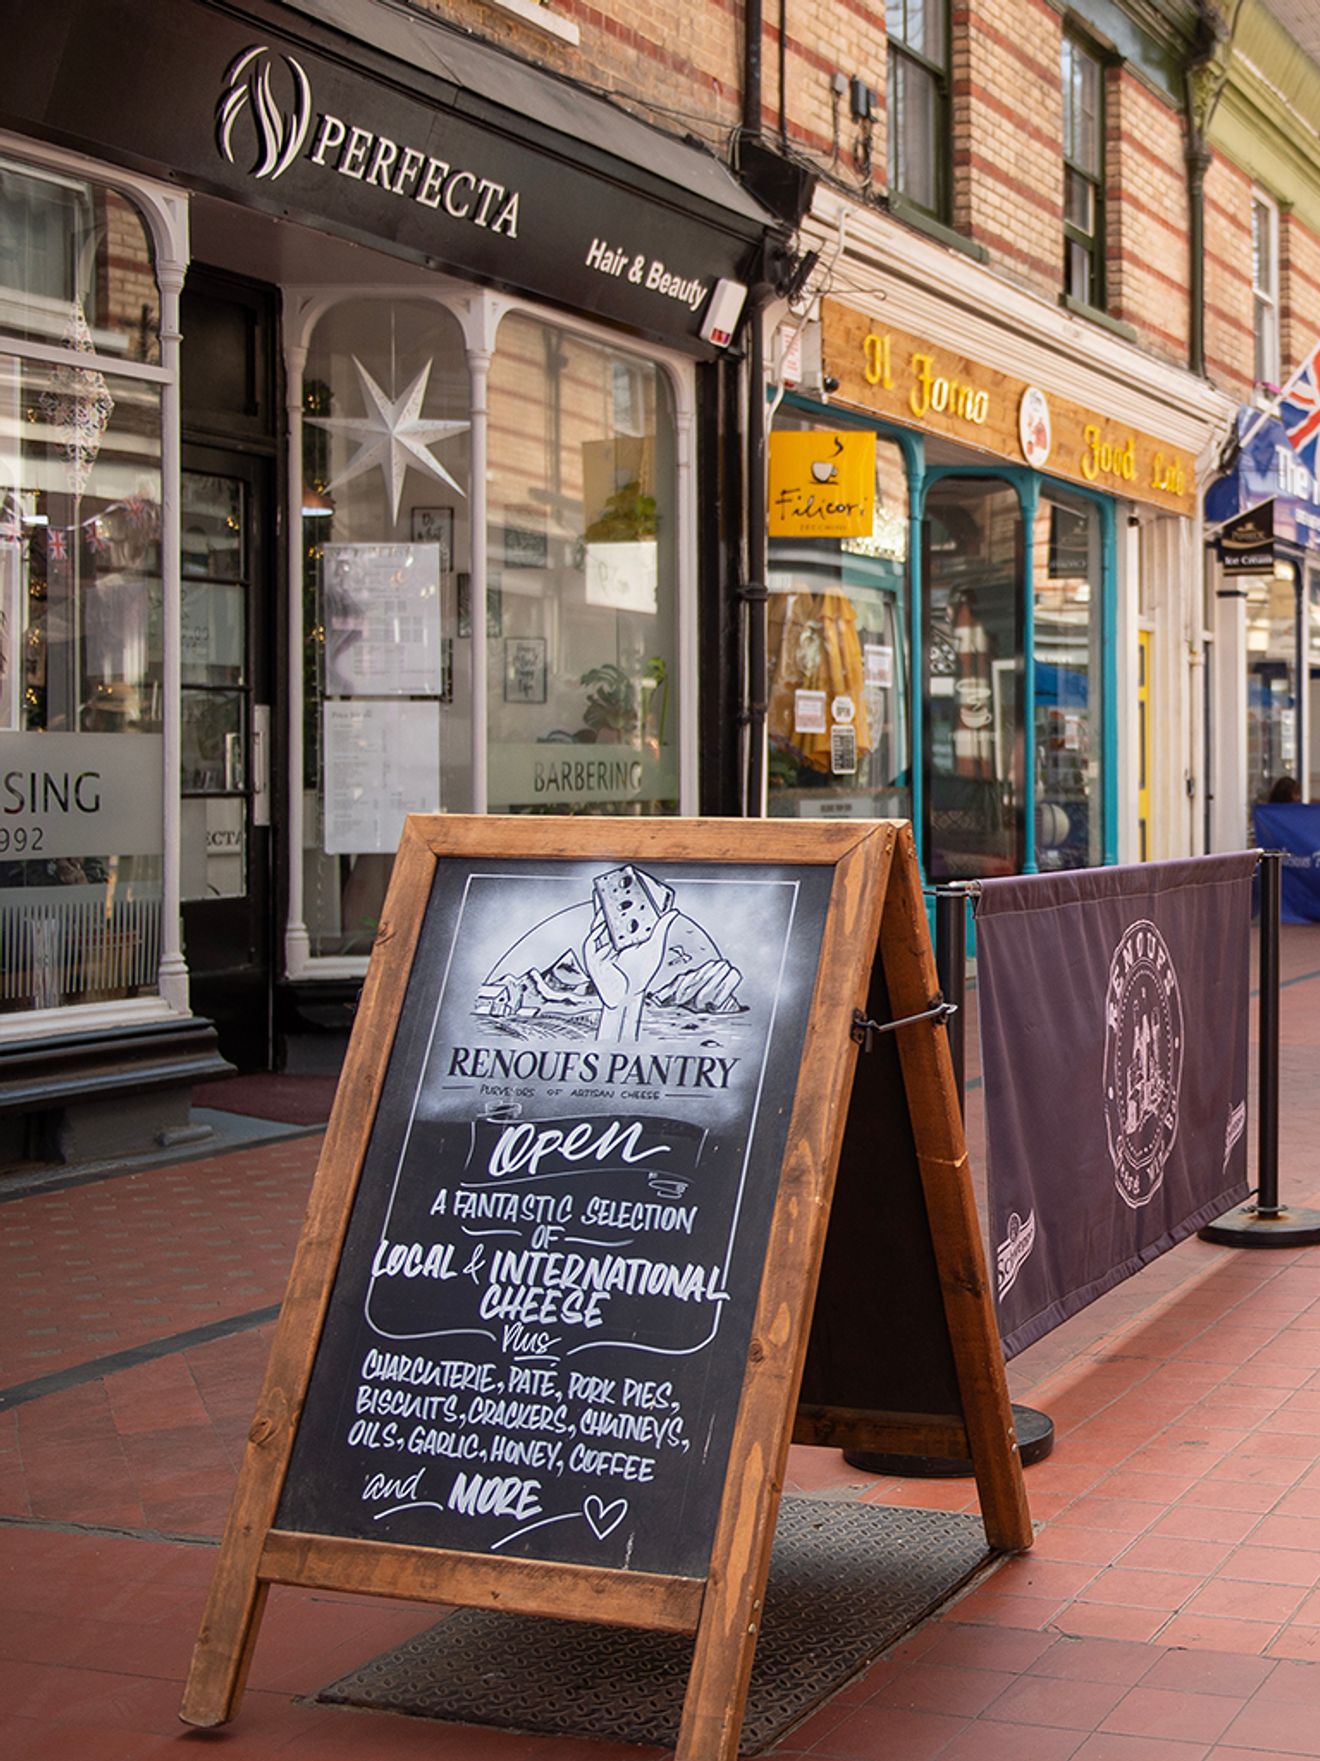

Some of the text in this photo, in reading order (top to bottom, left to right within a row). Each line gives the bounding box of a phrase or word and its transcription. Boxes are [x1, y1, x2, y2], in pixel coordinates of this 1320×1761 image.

[312, 114, 520, 239] PERFECTA
[585, 238, 708, 312] Hair & Beauty
[1274, 444, 1309, 501] The
[4, 771, 100, 814] SING
[534, 761, 641, 792] BARBERING
[447, 1047, 740, 1089] RENOUFS PANTRY
[546, 1088, 563, 1097] OF
[571, 1089, 615, 1099] ARTISAN
[621, 1091, 660, 1100] CHEESE
[488, 1121, 671, 1177] Open
[430, 1188, 698, 1235] A FANTASTIC SELECTION
[531, 1225, 566, 1249] OF
[371, 1240, 731, 1301] LOCAL & INTERNATIONAL
[479, 1283, 611, 1328] CHEESE
[362, 1348, 504, 1396] CHARCUTERIE,
[567, 1371, 615, 1405] PORK
[622, 1377, 681, 1415] PIES,
[355, 1385, 691, 1455] BISCUITS, CRACKERS, CHUTNEYS,
[348, 1419, 656, 1483] OILS, GARLIC, HONEY, COFFEE
[362, 1468, 543, 1520] and MORE
